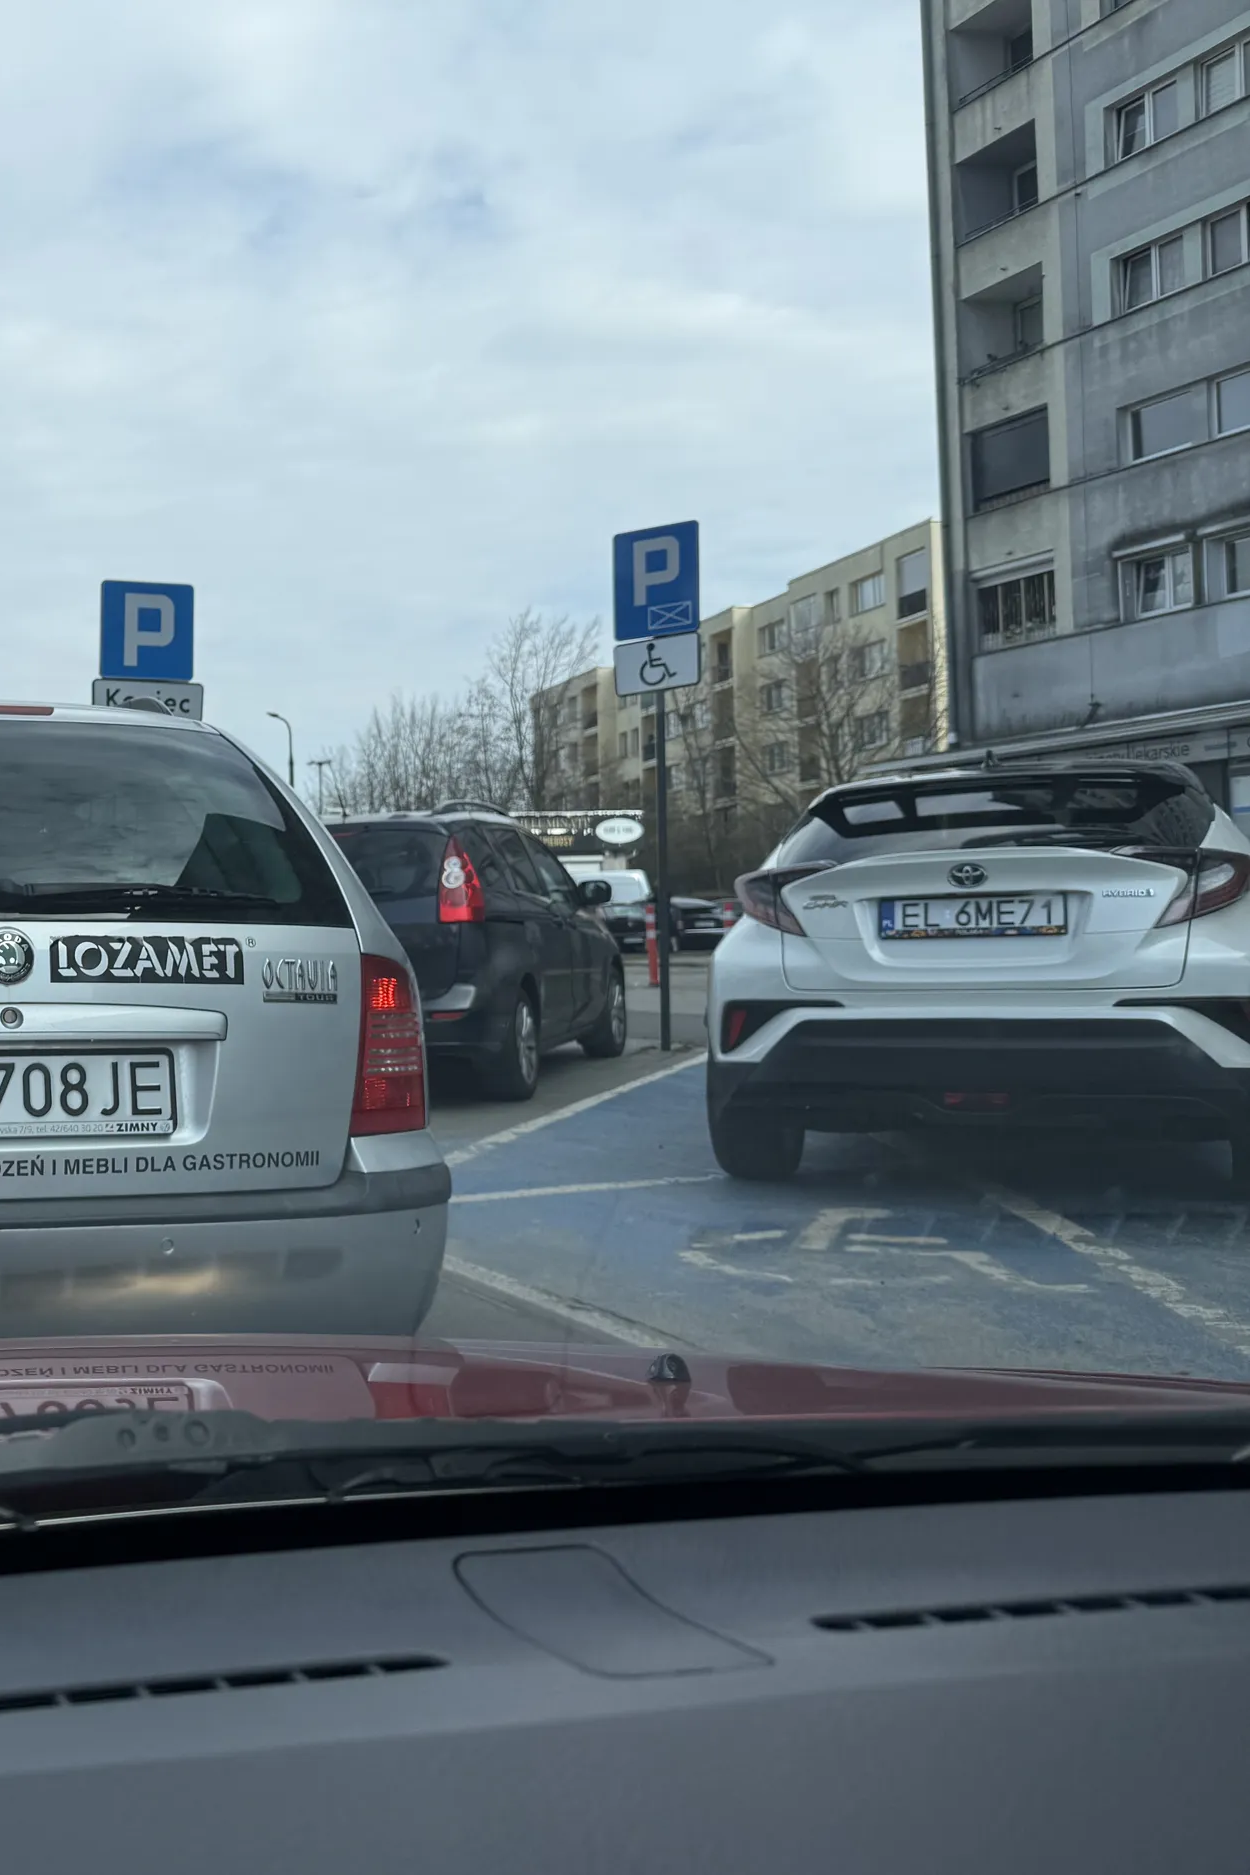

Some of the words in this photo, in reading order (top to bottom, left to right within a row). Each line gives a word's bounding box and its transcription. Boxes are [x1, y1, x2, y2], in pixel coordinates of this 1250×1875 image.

[632, 535, 680, 606] P
[123, 593, 175, 666] P
[106, 688, 190, 713] Kec
[902, 903, 940, 928] EL
[954, 900, 1053, 926] 6ME71
[57, 940, 240, 979] LOZAMET
[262, 958, 338, 992] OCTAVIA
[116, 1122, 159, 1132] ZIMNY
[51, 1160, 57, 1175] I
[63, 1156, 129, 1175] MEBLI
[135, 1156, 176, 1173] DLA
[182, 1150, 320, 1172] GASTRONOMII
